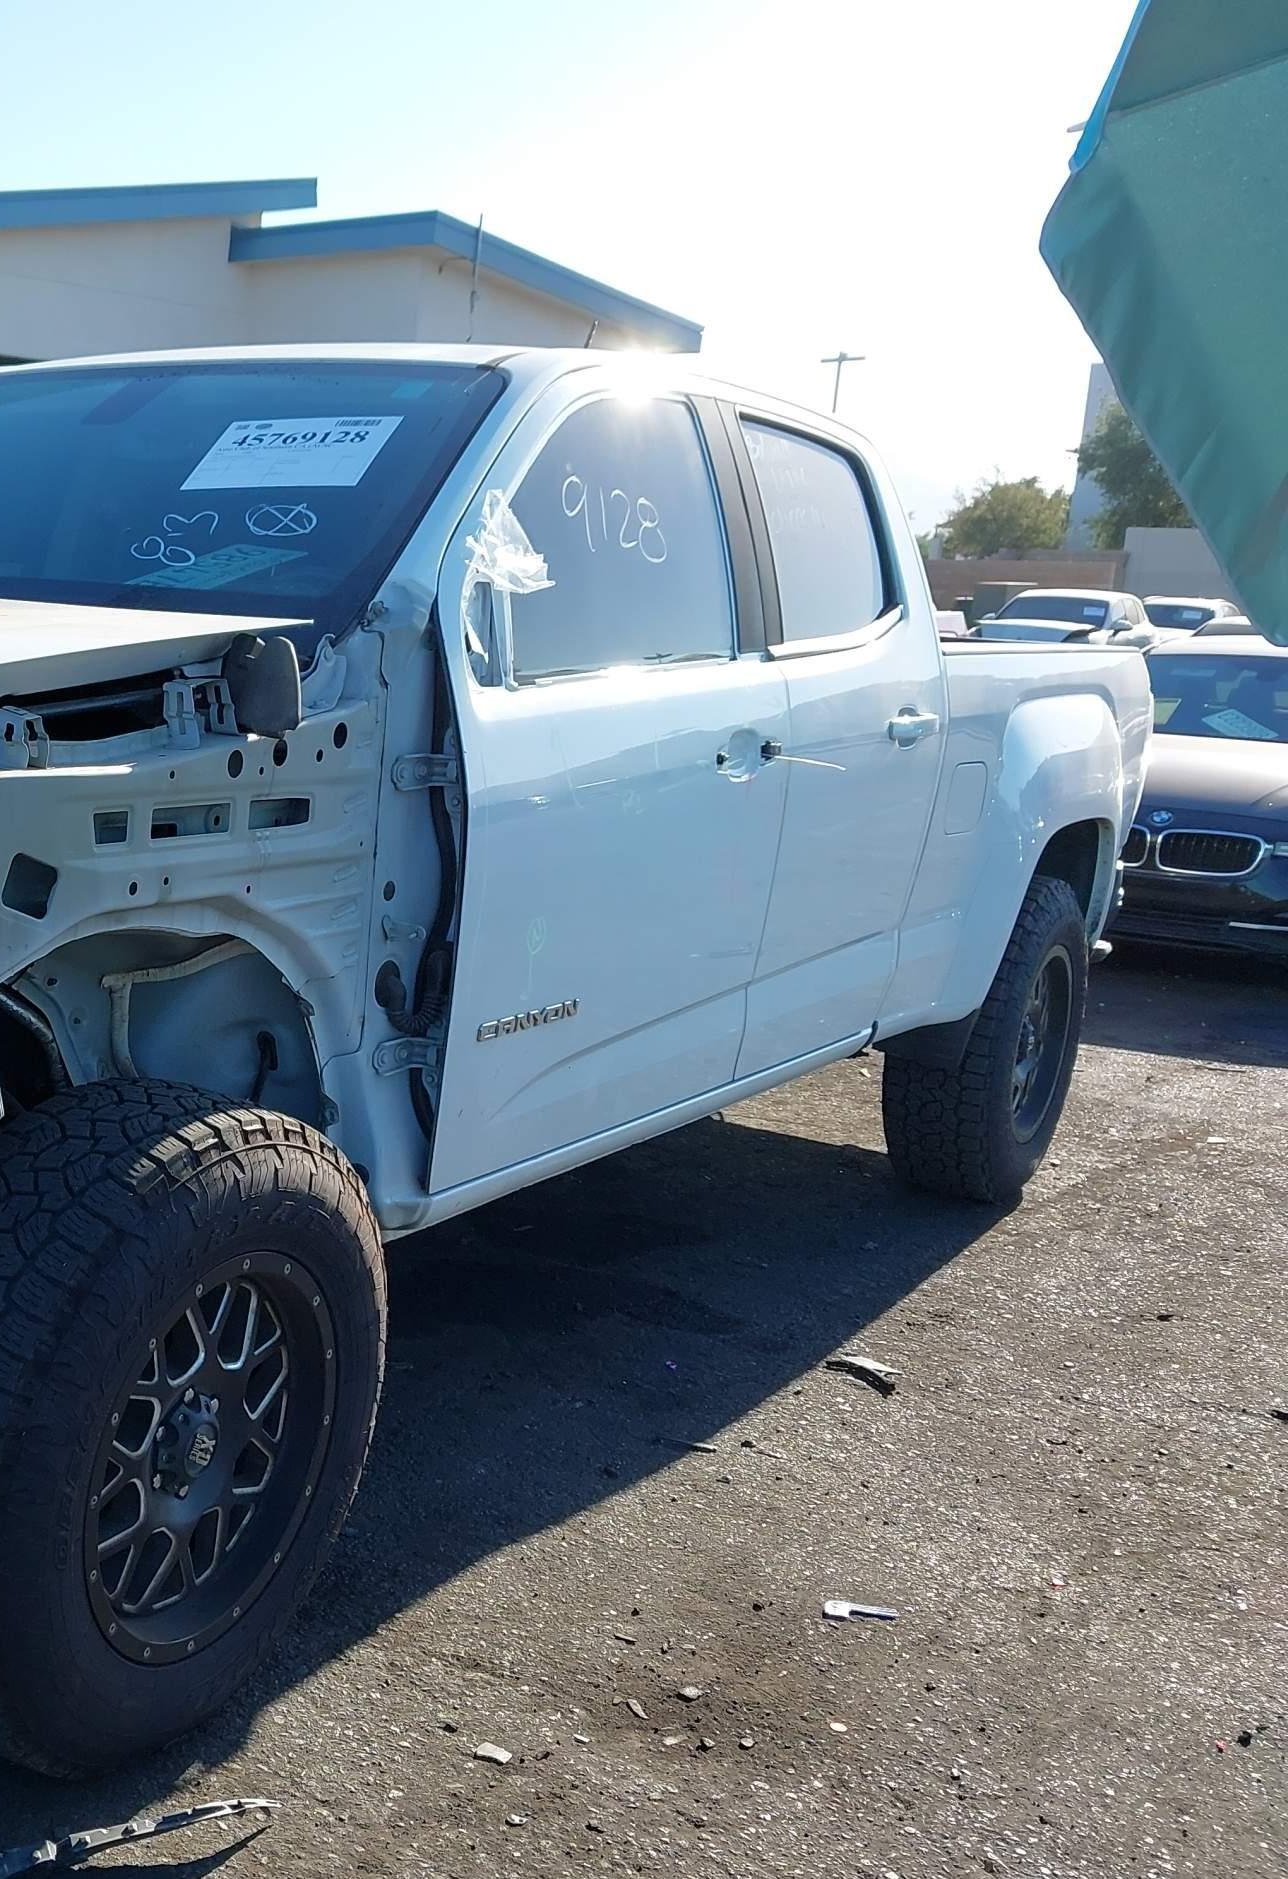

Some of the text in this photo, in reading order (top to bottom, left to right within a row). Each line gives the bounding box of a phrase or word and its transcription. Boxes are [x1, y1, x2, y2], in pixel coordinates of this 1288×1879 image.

[232, 430, 370, 447] 45769128
[561, 473, 667, 563] 9128
[476, 998, 581, 1042] CANYON
